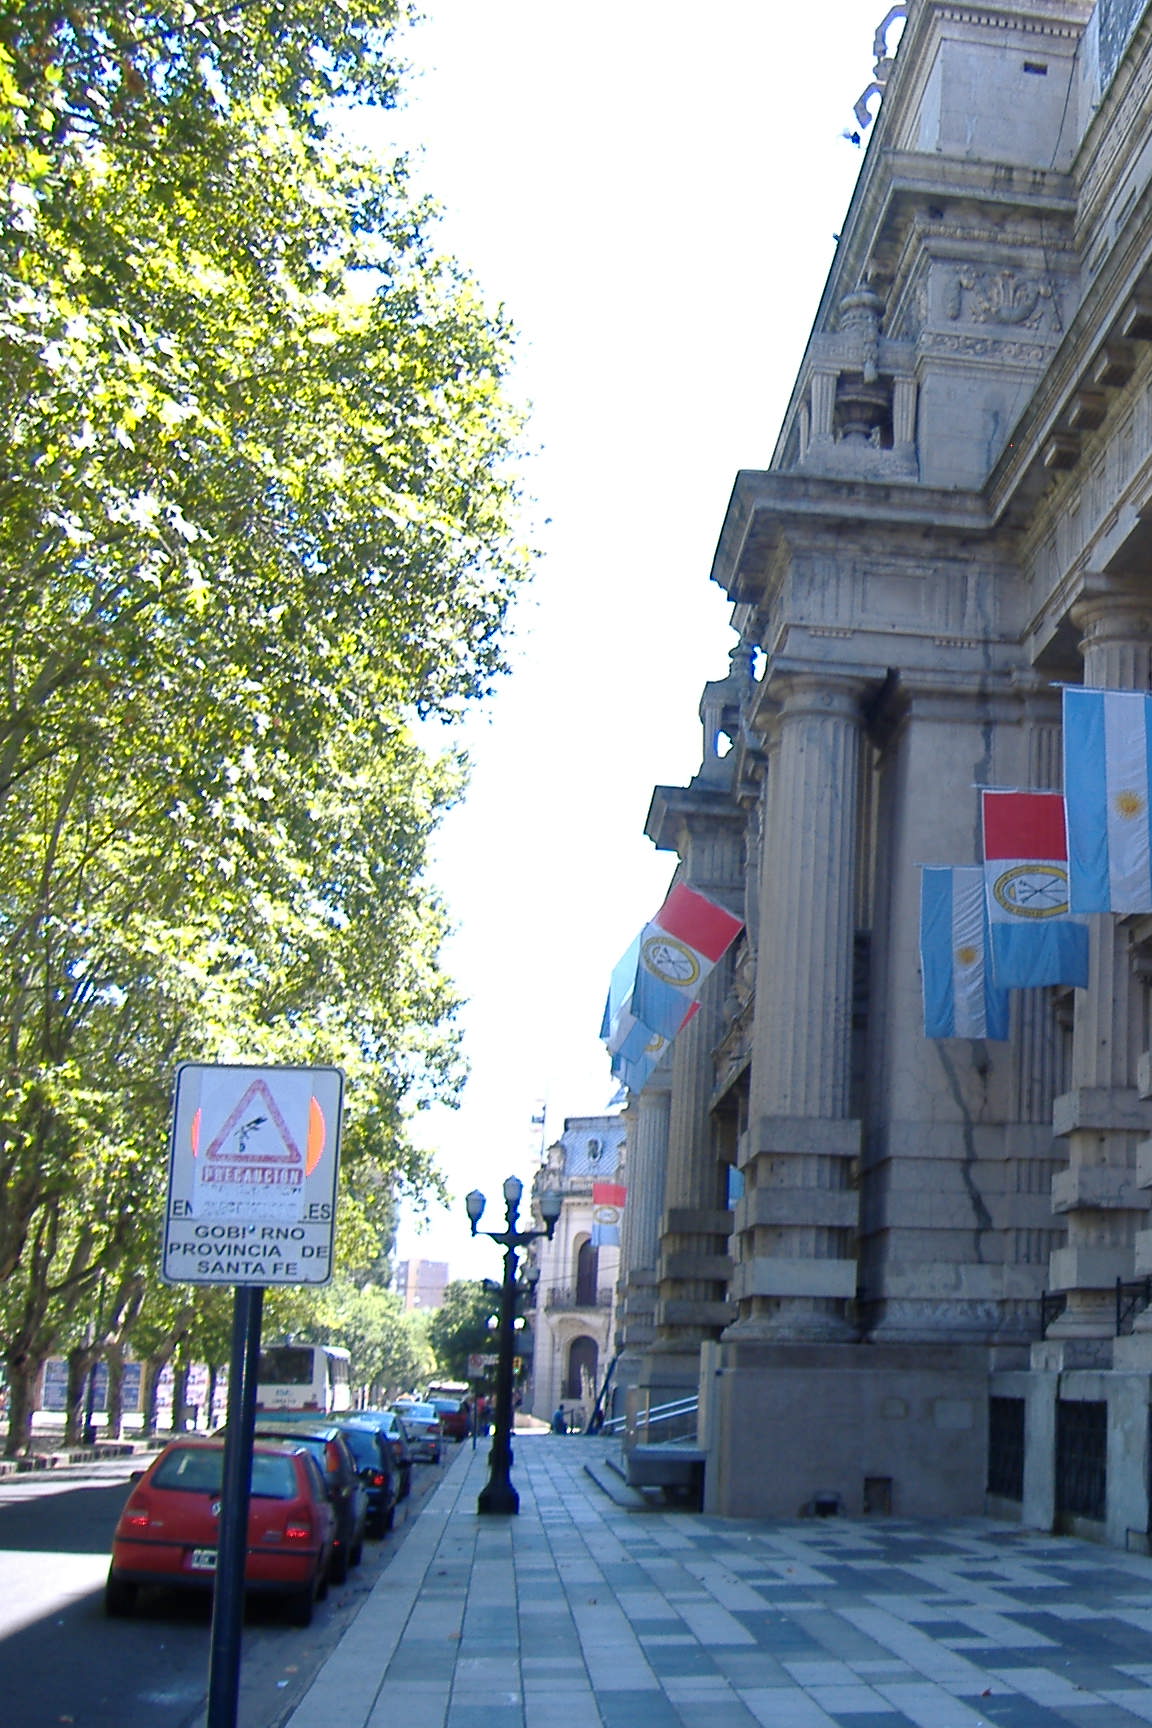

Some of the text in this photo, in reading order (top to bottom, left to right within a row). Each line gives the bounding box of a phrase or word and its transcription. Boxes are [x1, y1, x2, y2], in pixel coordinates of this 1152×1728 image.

[194, 1225, 305, 1240] GOBIRNO
[168, 1242, 329, 1259] PROVINCIA DE
[197, 1261, 298, 1275] SANTA FE
